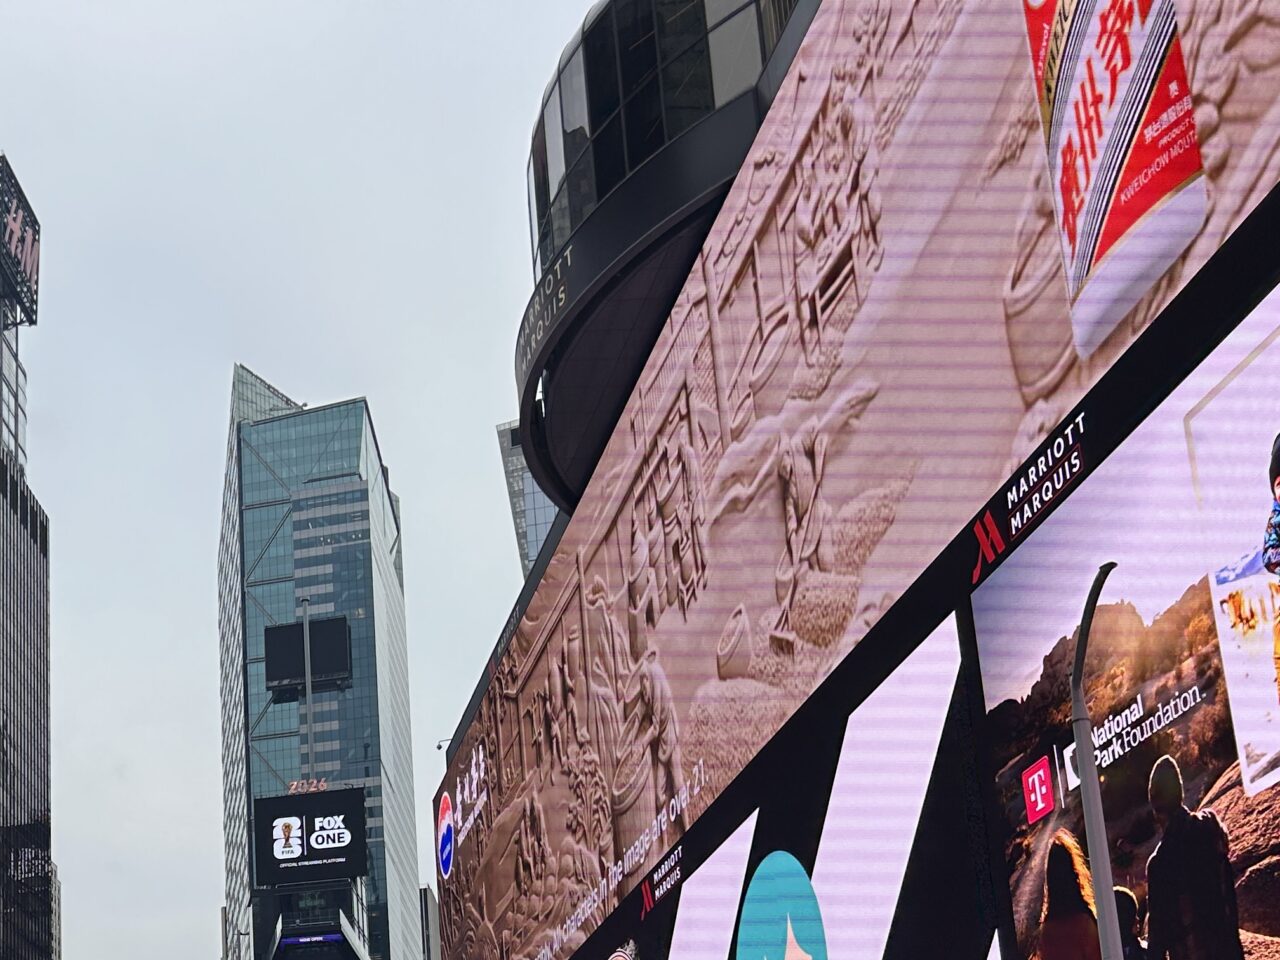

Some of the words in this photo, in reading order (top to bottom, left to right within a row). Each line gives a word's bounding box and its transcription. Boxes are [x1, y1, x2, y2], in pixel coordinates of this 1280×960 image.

[1120, 153, 1170, 206] KWEICHOW
[519, 244, 573, 352] MARRIOTT
[521, 285, 566, 372] MARQUIS
[1006, 411, 1086, 509] MARRIOTT
[1010, 451, 1081, 535] MARQUIS
[1091, 693, 1145, 749] National
[1123, 685, 1202, 754] Foundation
[288, 777, 328, 794] 2026
[314, 815, 346, 831] FOX
[314, 831, 346, 846] ONE
[623, 827, 651, 875] image
[651, 807, 668, 842] are
[669, 781, 691, 823] over
[692, 757, 709, 795] 21.
[653, 845, 683, 884] MARRIOTT
[654, 866, 681, 899] MARQUIS
